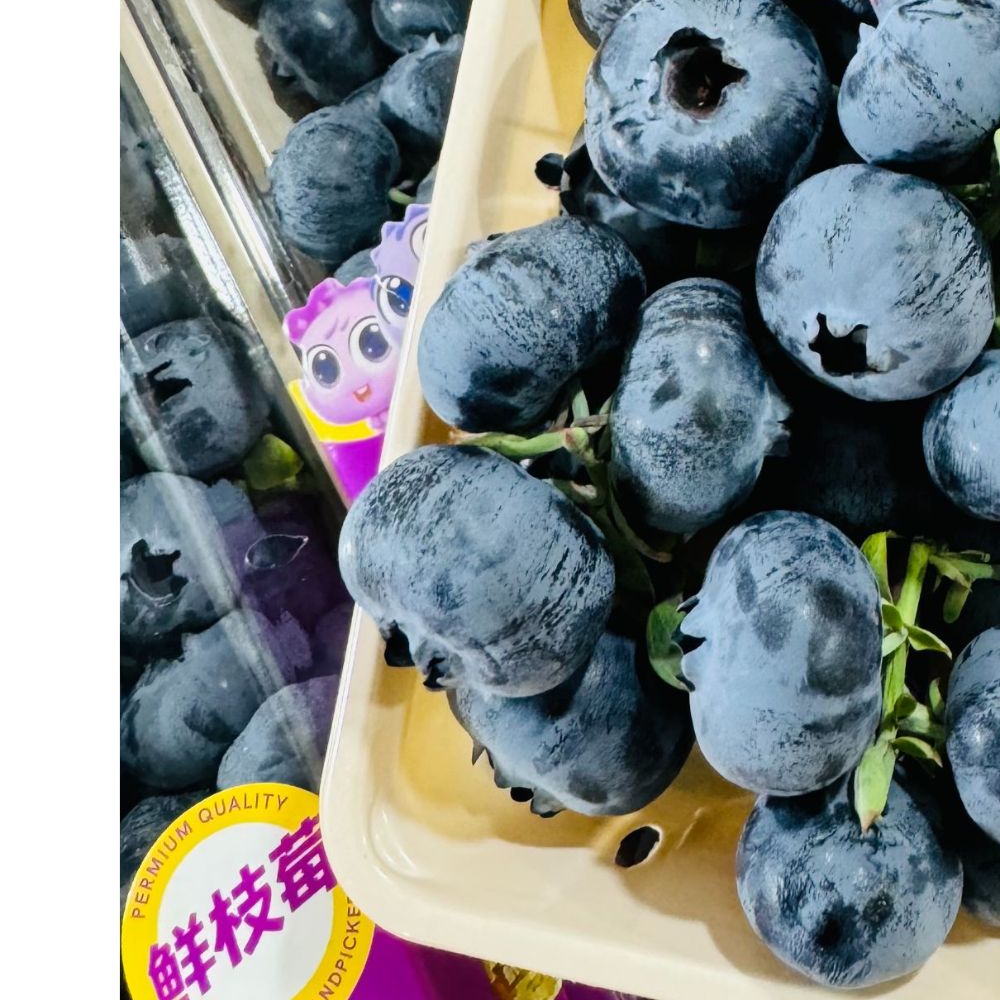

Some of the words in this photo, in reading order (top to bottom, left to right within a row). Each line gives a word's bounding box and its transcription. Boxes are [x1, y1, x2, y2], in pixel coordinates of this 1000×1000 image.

[132, 820, 194, 919] PERMIUM
[197, 792, 289, 824] QUALITY
[148, 813, 338, 1000] 鲜枝莓
